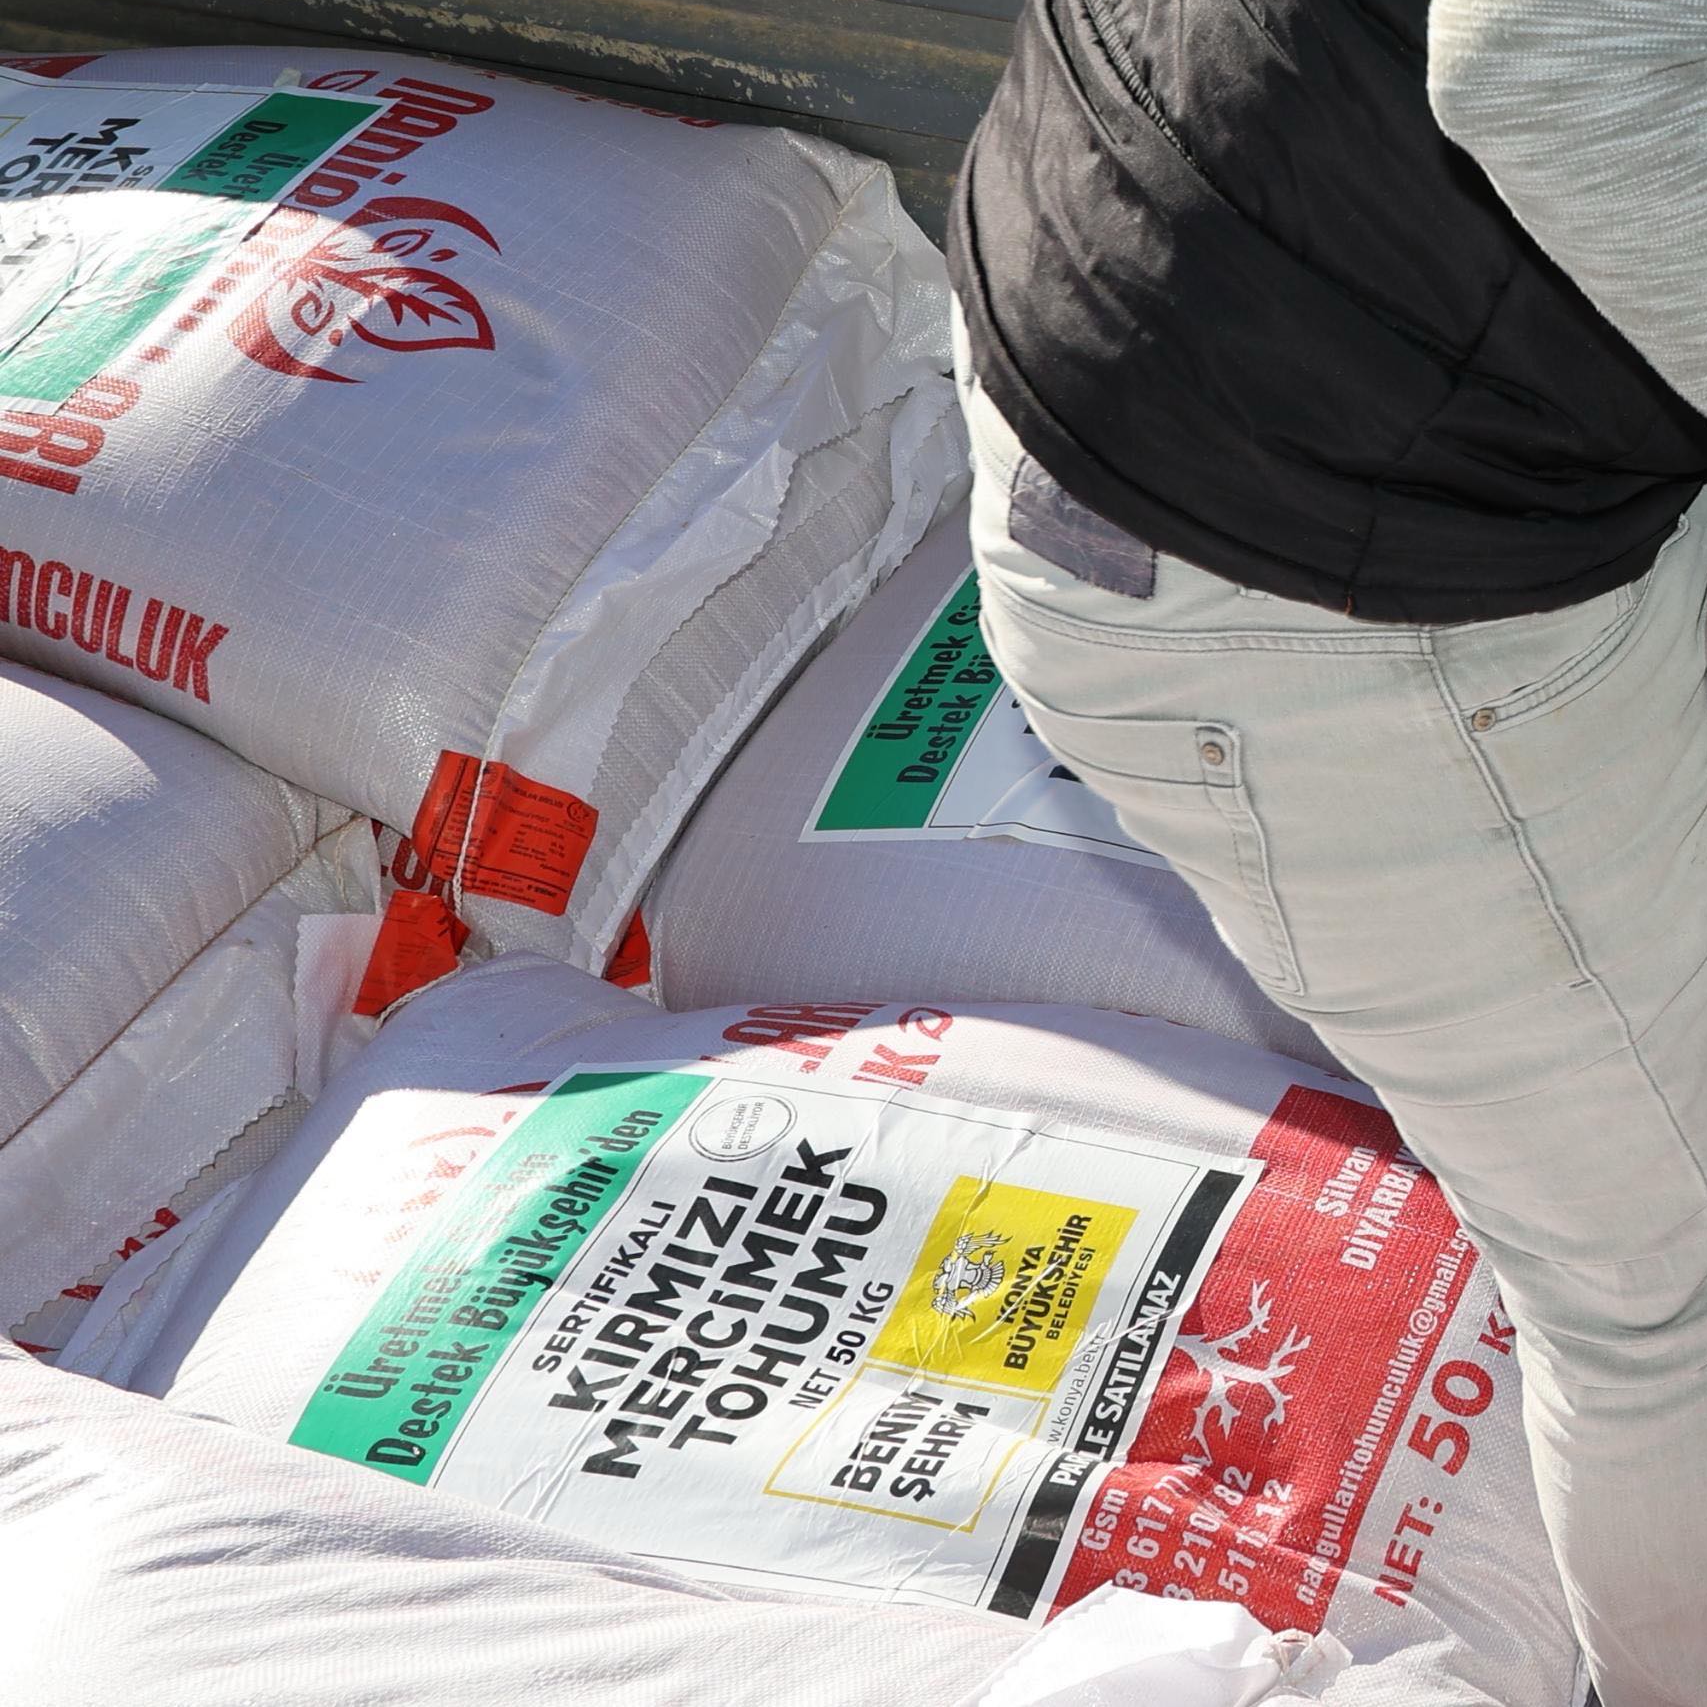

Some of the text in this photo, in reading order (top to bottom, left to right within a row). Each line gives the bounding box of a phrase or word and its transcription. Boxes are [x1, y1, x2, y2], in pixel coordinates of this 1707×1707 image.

[866, 634, 974, 742] Üretmek
[896, 694, 982, 783] Destek
[1315, 1145, 1379, 1217] Silvan
[364, 1340, 491, 1467] Destek
[446, 1107, 664, 1331] Büyükşehir'den
[532, 1200, 677, 1374] SERTİFİKALI
[547, 1175, 760, 1412] KIRMIZI
[580, 1137, 854, 1480] MERCİMEK
[668, 1182, 889, 1451] TOHUMU
[993, 1245, 1046, 1325] KONYA
[1003, 1213, 1093, 1371] BÜYÜKŞEHİR
[1046, 1247, 1097, 1341] BELEDİYESİ
[787, 1279, 895, 1411] NET 50 KG
[1099, 1270, 1182, 1424] SATILAMAZ
[1407, 1357, 1495, 1479] 50
[1080, 1488, 1130, 1552] Gsm
[1125, 1494, 1174, 1560] 617
[1215, 1464, 1253, 1505] 82
[1255, 1479, 1293, 1519] 12
[1373, 1493, 1445, 1609] NET:
